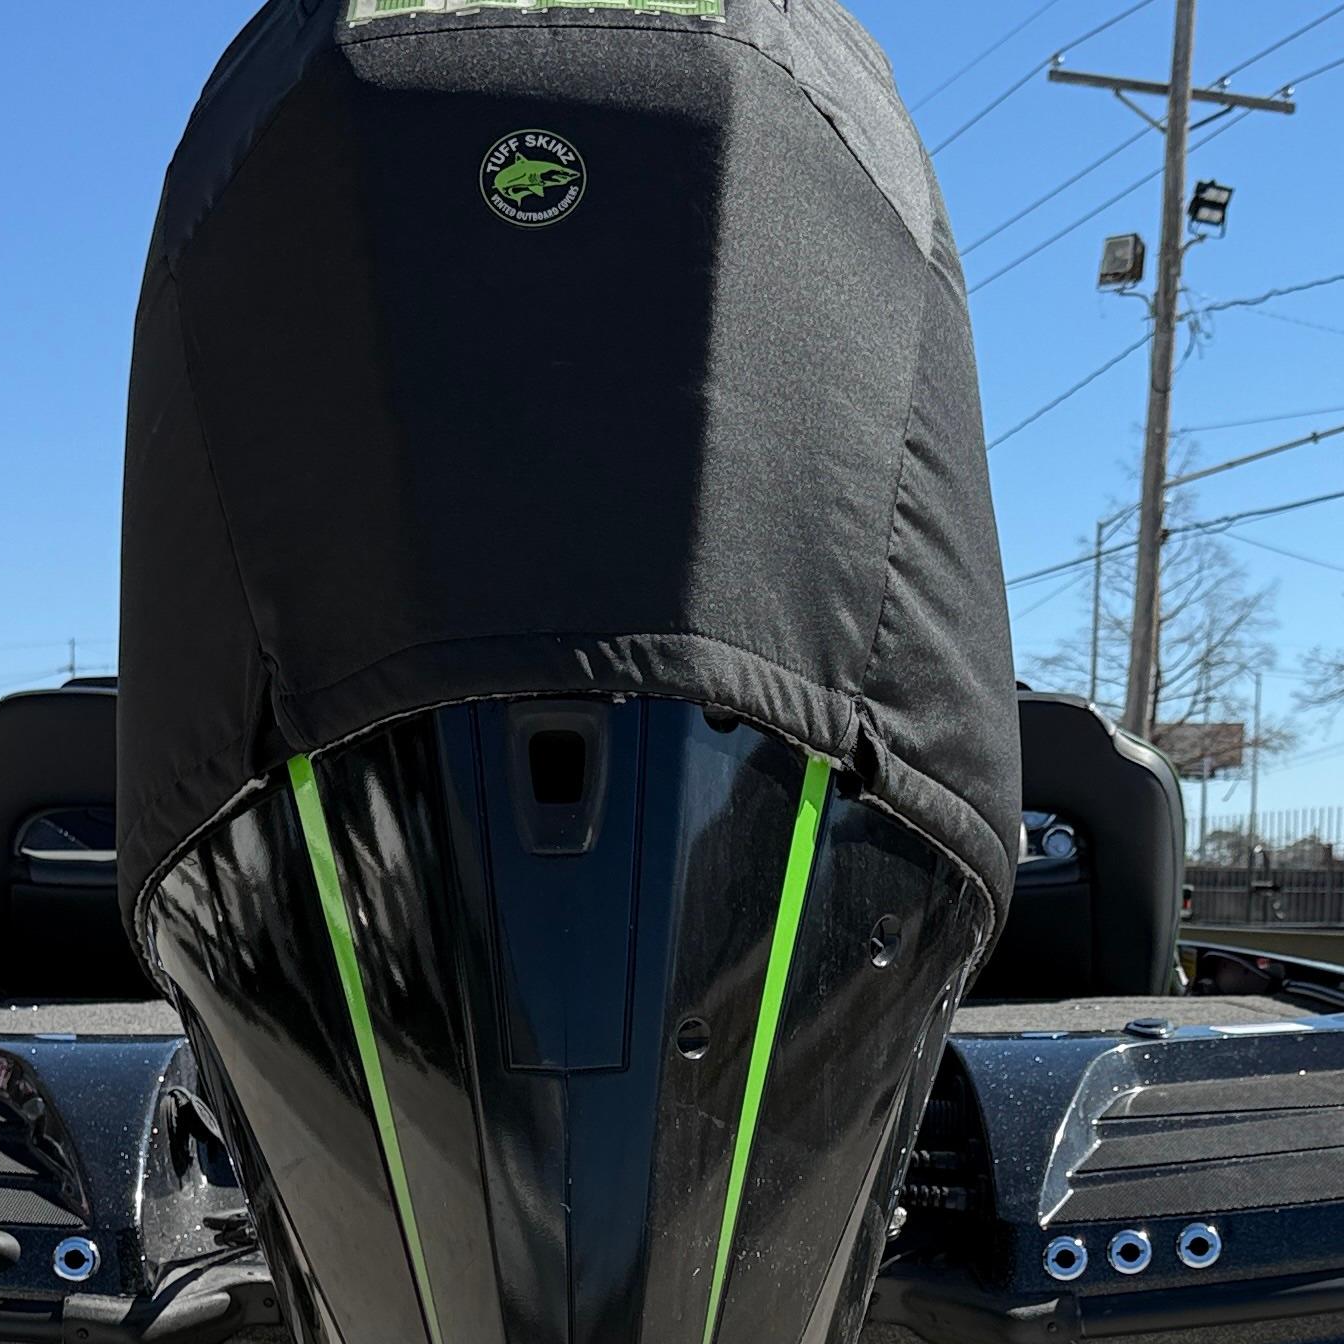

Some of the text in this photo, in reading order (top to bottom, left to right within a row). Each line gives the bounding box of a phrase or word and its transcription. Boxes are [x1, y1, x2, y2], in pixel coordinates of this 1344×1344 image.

[486, 134, 576, 173] TUFF SKINZ
[491, 185, 579, 221] VENTED OUTBOARD COVERS
